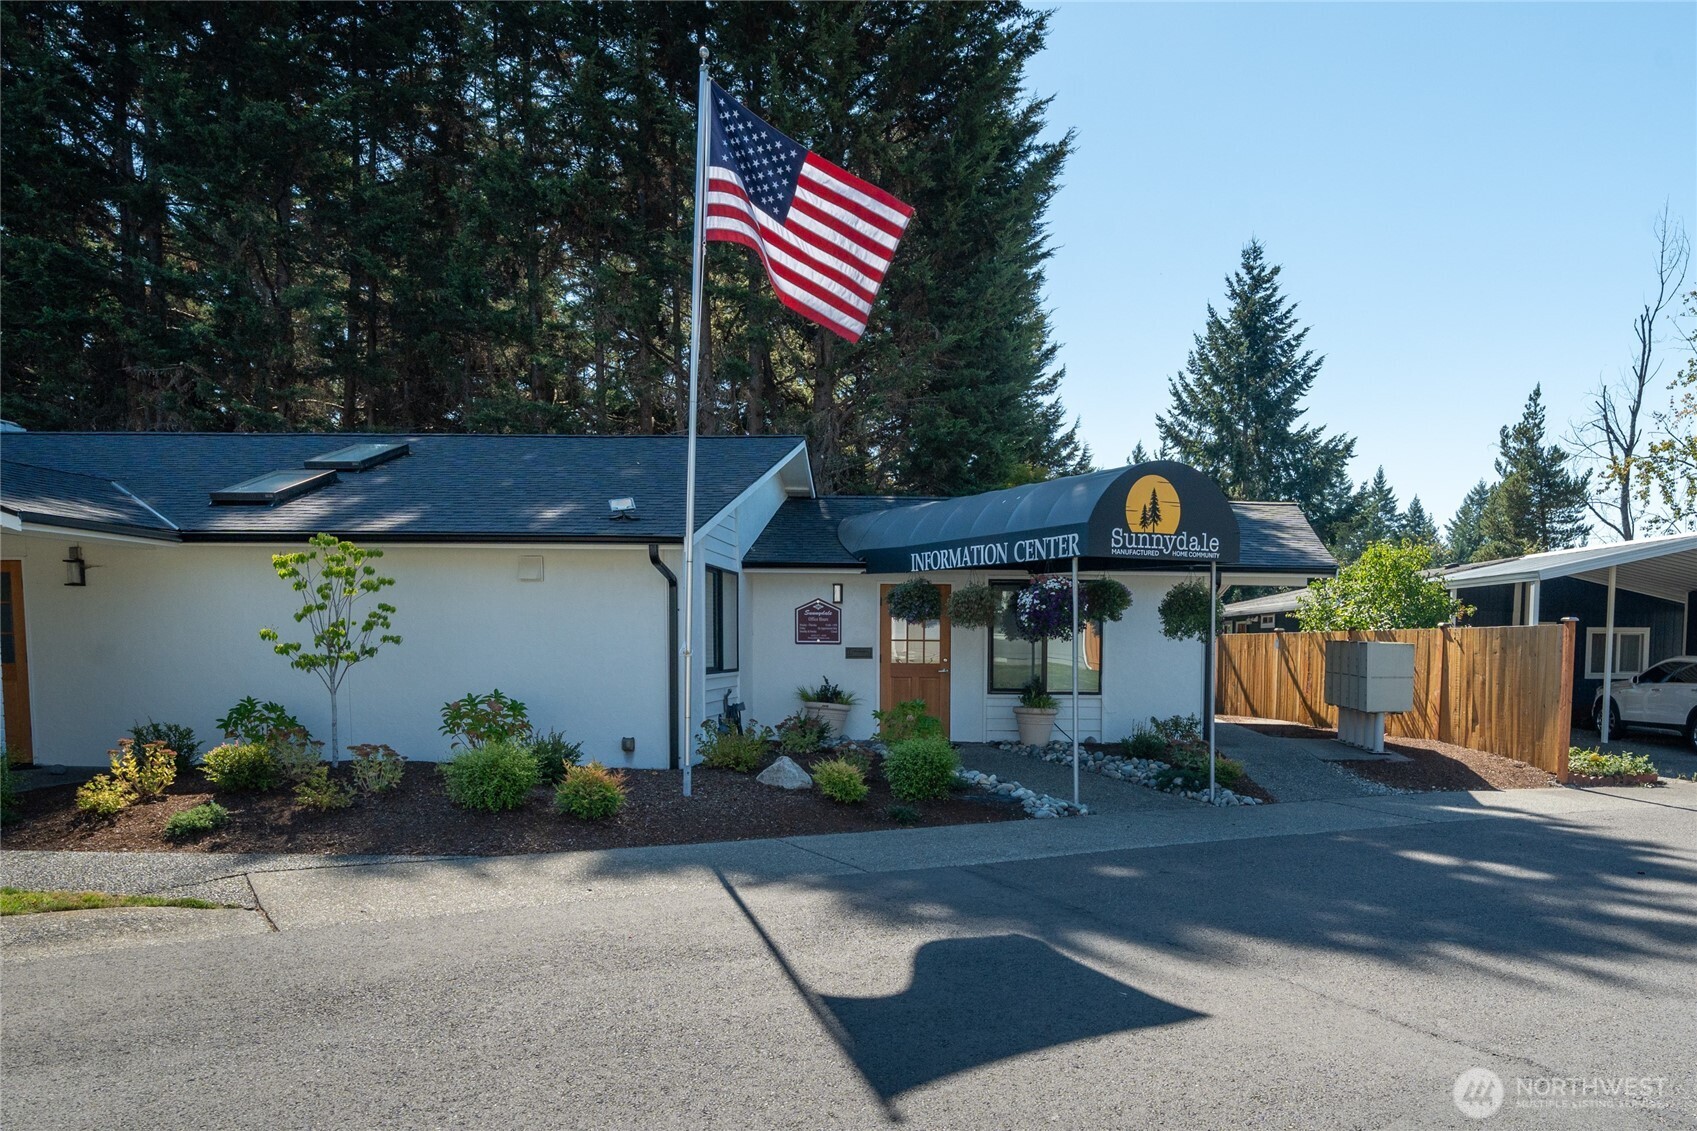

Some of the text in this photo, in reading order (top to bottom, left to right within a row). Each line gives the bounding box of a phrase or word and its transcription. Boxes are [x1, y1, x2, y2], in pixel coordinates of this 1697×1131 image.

[911, 533, 1080, 572] INFORMATION CENTER
[1111, 528, 1219, 554] Sunnydale
[1111, 548, 1159, 557] MANUFACTURED
[1188, 551, 1220, 559] COMMUNITY
